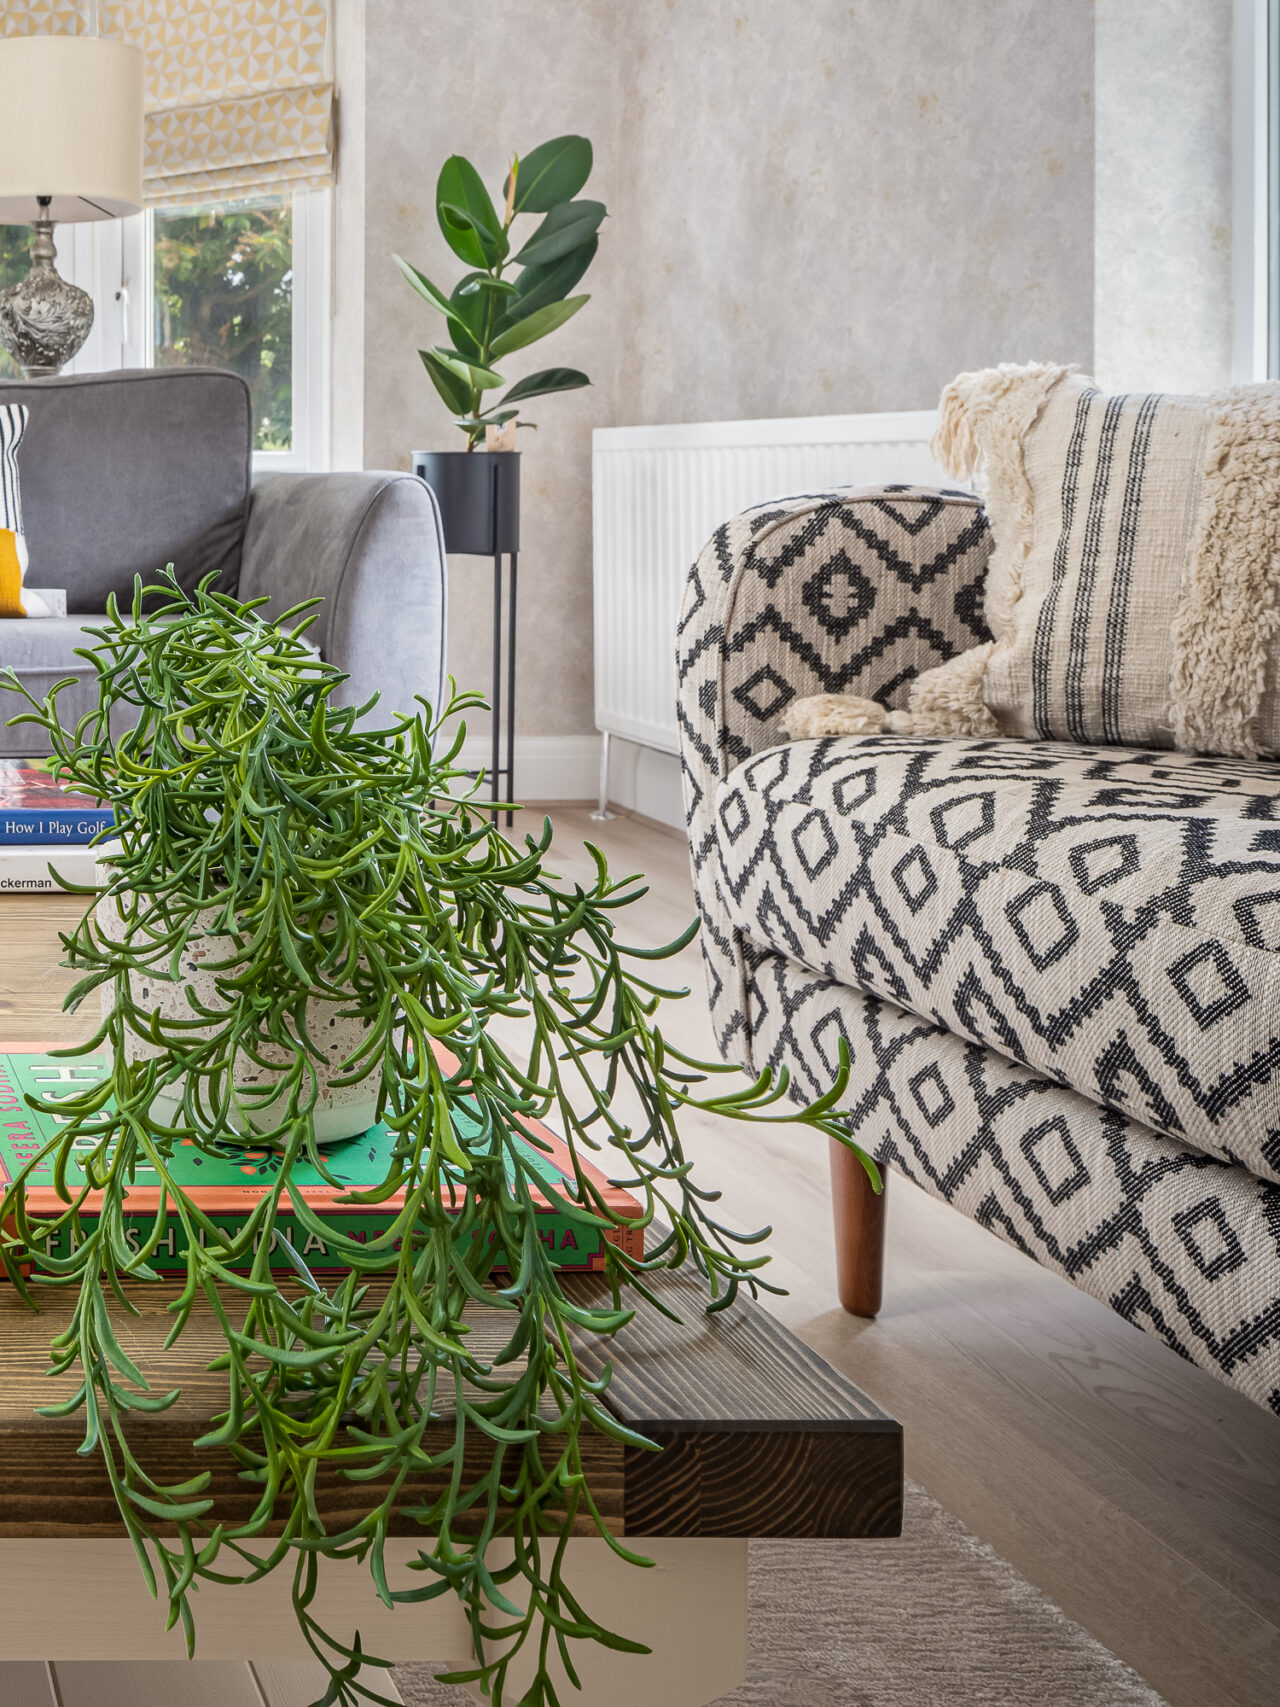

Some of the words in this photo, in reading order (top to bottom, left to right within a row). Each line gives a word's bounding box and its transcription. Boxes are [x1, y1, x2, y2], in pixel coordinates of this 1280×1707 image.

[5, 822, 34, 834] How
[39, 822, 44, 834] I
[49, 822, 73, 837] Play
[77, 821, 106, 835] Golf
[45, 1228, 175, 1256] FRSH
